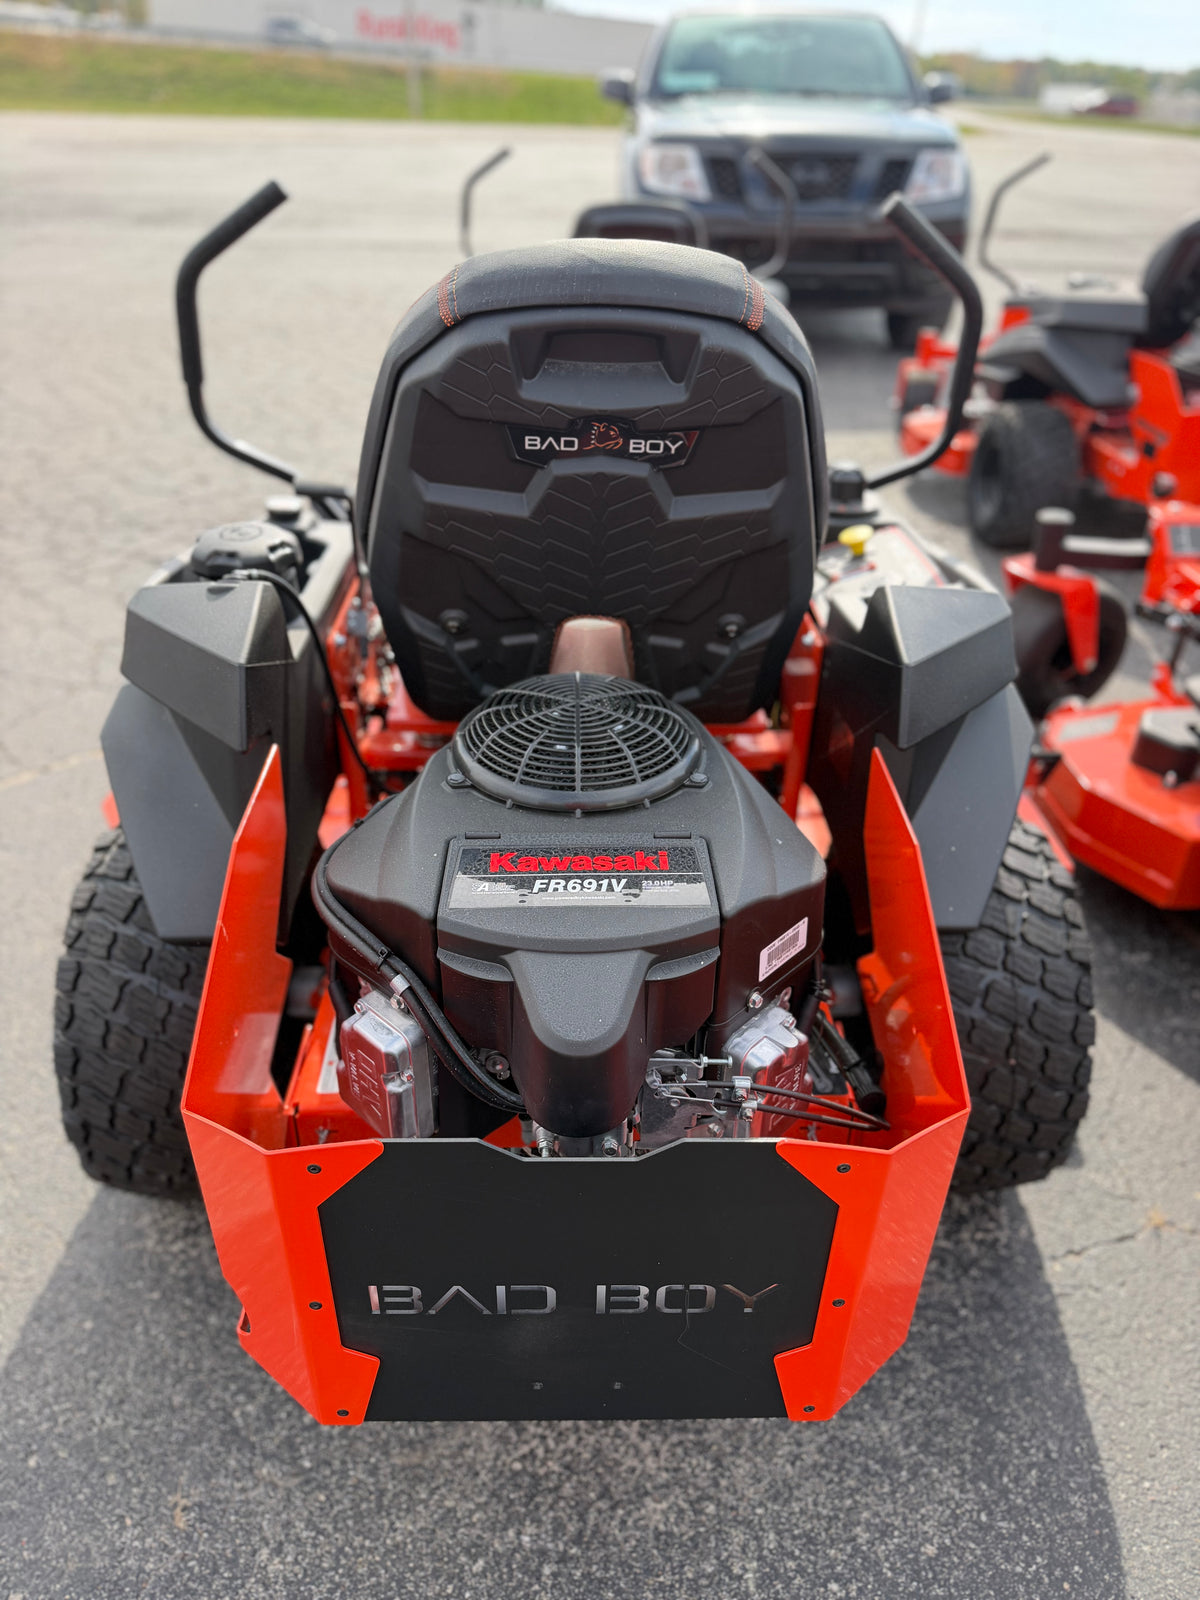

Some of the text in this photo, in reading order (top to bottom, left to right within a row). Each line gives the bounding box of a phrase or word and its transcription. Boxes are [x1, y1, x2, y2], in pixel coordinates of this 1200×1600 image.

[524, 435, 684, 454] BAD BOY
[489, 851, 670, 873] Kawasaki
[532, 878, 628, 894] FR691V
[367, 1283, 783, 1315] BAD BOY
